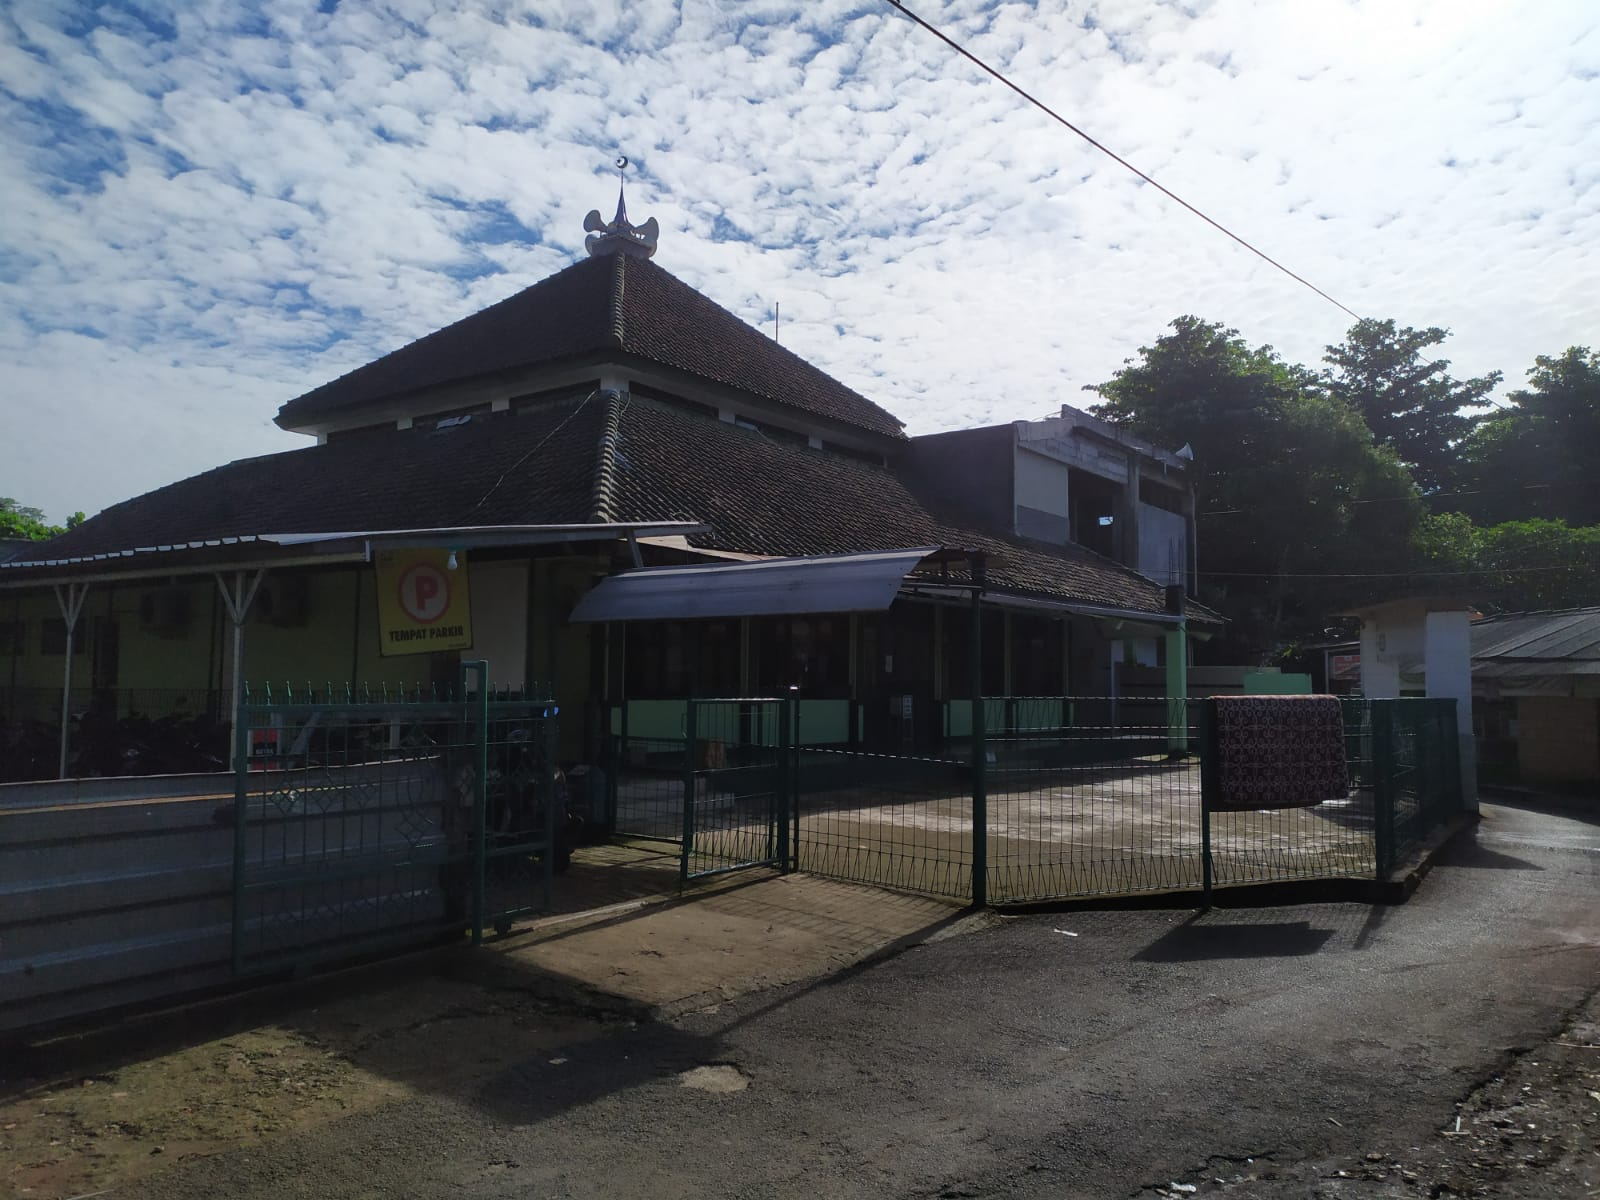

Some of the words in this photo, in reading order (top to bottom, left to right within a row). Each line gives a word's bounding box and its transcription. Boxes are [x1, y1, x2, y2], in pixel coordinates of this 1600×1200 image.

[415, 575, 438, 611] P
[389, 628, 426, 642] TEMPAT
[429, 625, 464, 639] PARKIR
